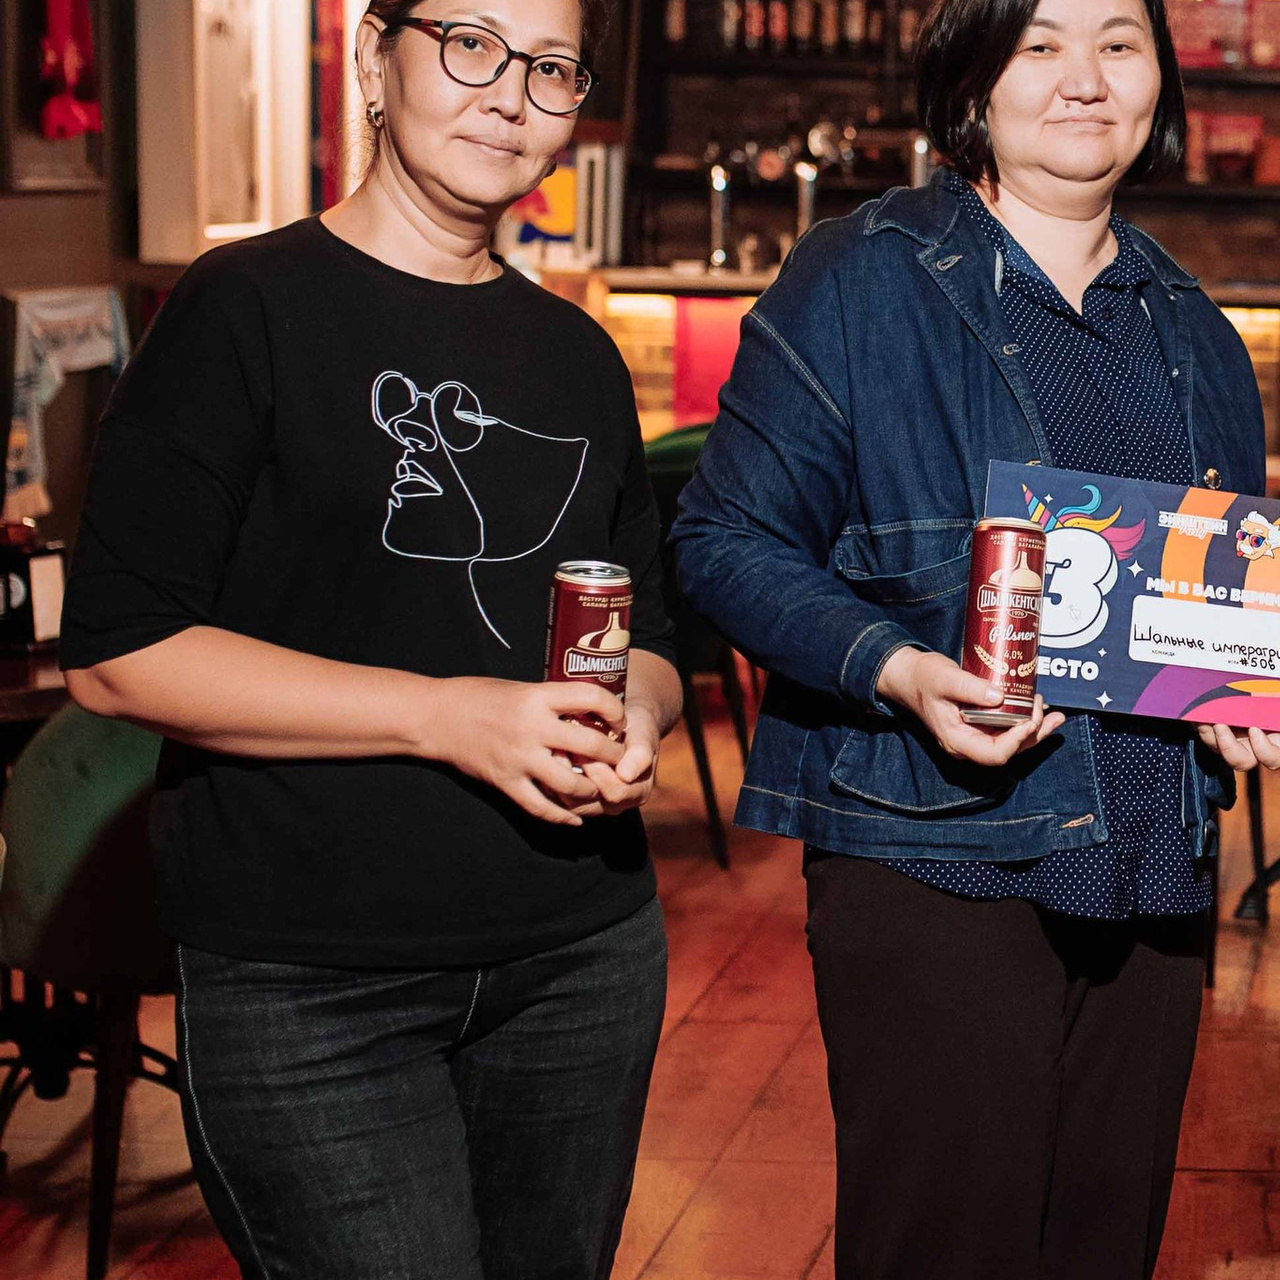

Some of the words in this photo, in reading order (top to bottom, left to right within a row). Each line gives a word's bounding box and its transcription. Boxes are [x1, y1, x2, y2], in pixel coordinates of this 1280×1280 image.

[1036, 526, 1119, 649] 3
[1146, 577, 1176, 593] МЫ
[1192, 583, 1228, 600] ВАС
[1134, 624, 1205, 650] Шальные
[1037, 654, 1100, 681] ЕСТО
